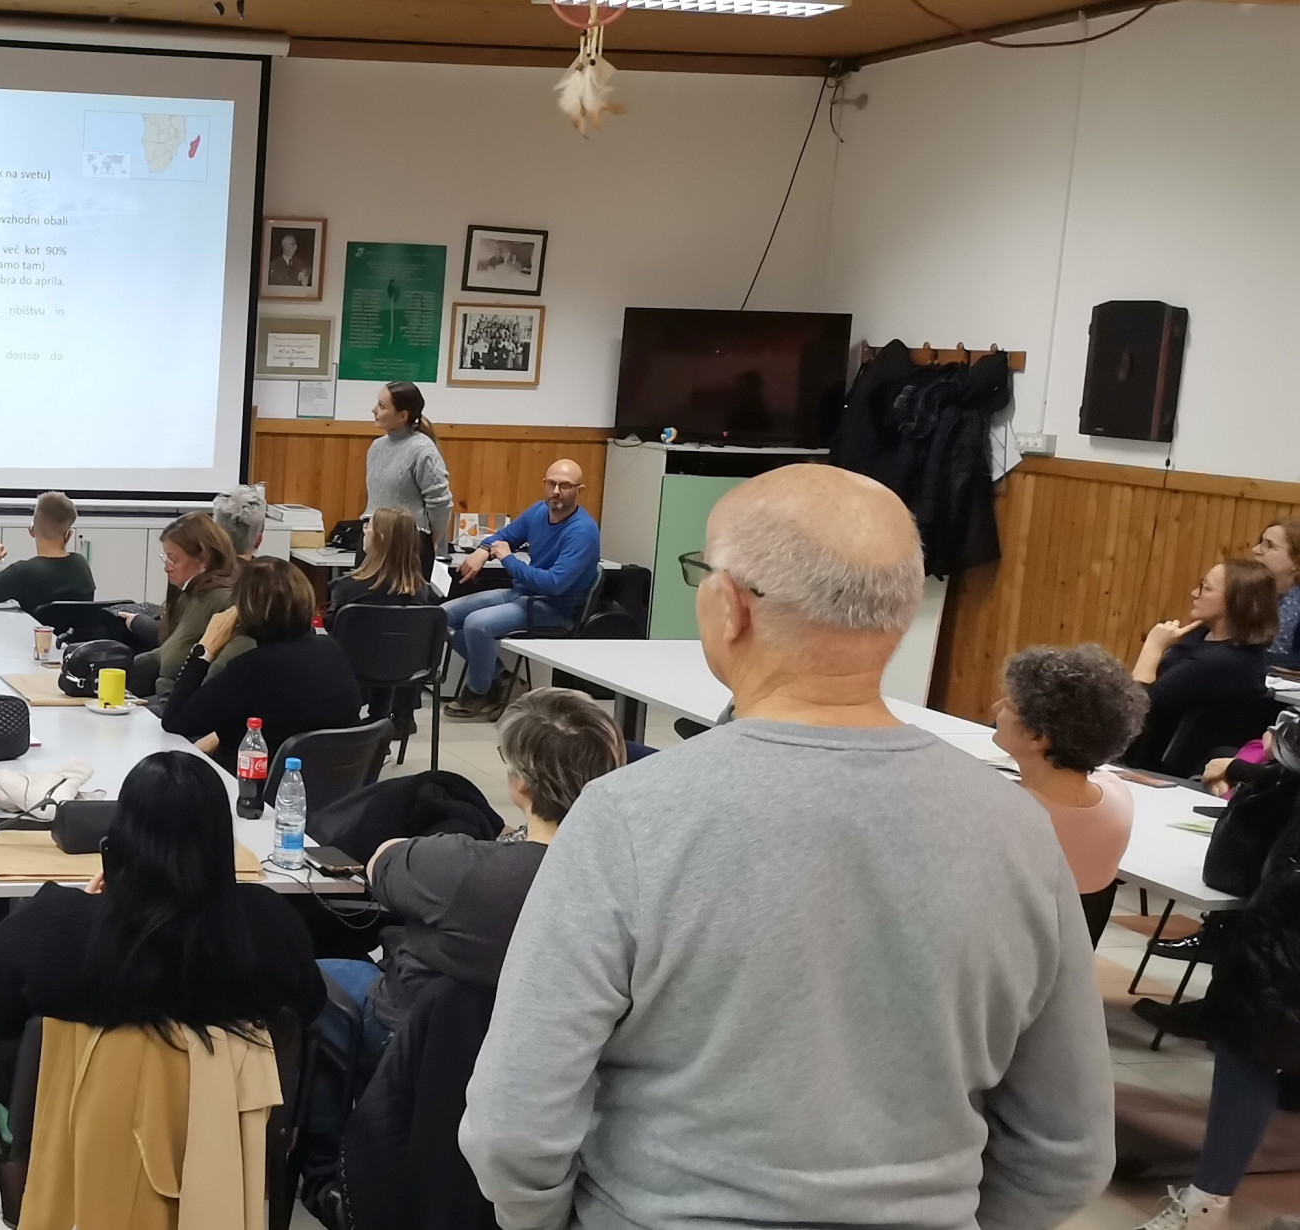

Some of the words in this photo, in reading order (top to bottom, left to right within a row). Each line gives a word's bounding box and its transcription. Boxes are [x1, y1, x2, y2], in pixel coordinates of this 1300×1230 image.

[5, 170, 18, 178] na
[20, 170, 51, 182] svetu)
[43, 216, 68, 226] obali
[2, 244, 20, 254] več
[24, 244, 40, 255] kot
[46, 246, 67, 256] 90%
[22, 260, 46, 272] tam)
[19, 276, 32, 286] do
[8, 305, 46, 316] ribištvu
[56, 306, 65, 316] in
[6, 350, 40, 363] dostop
[50, 351, 63, 361] do
